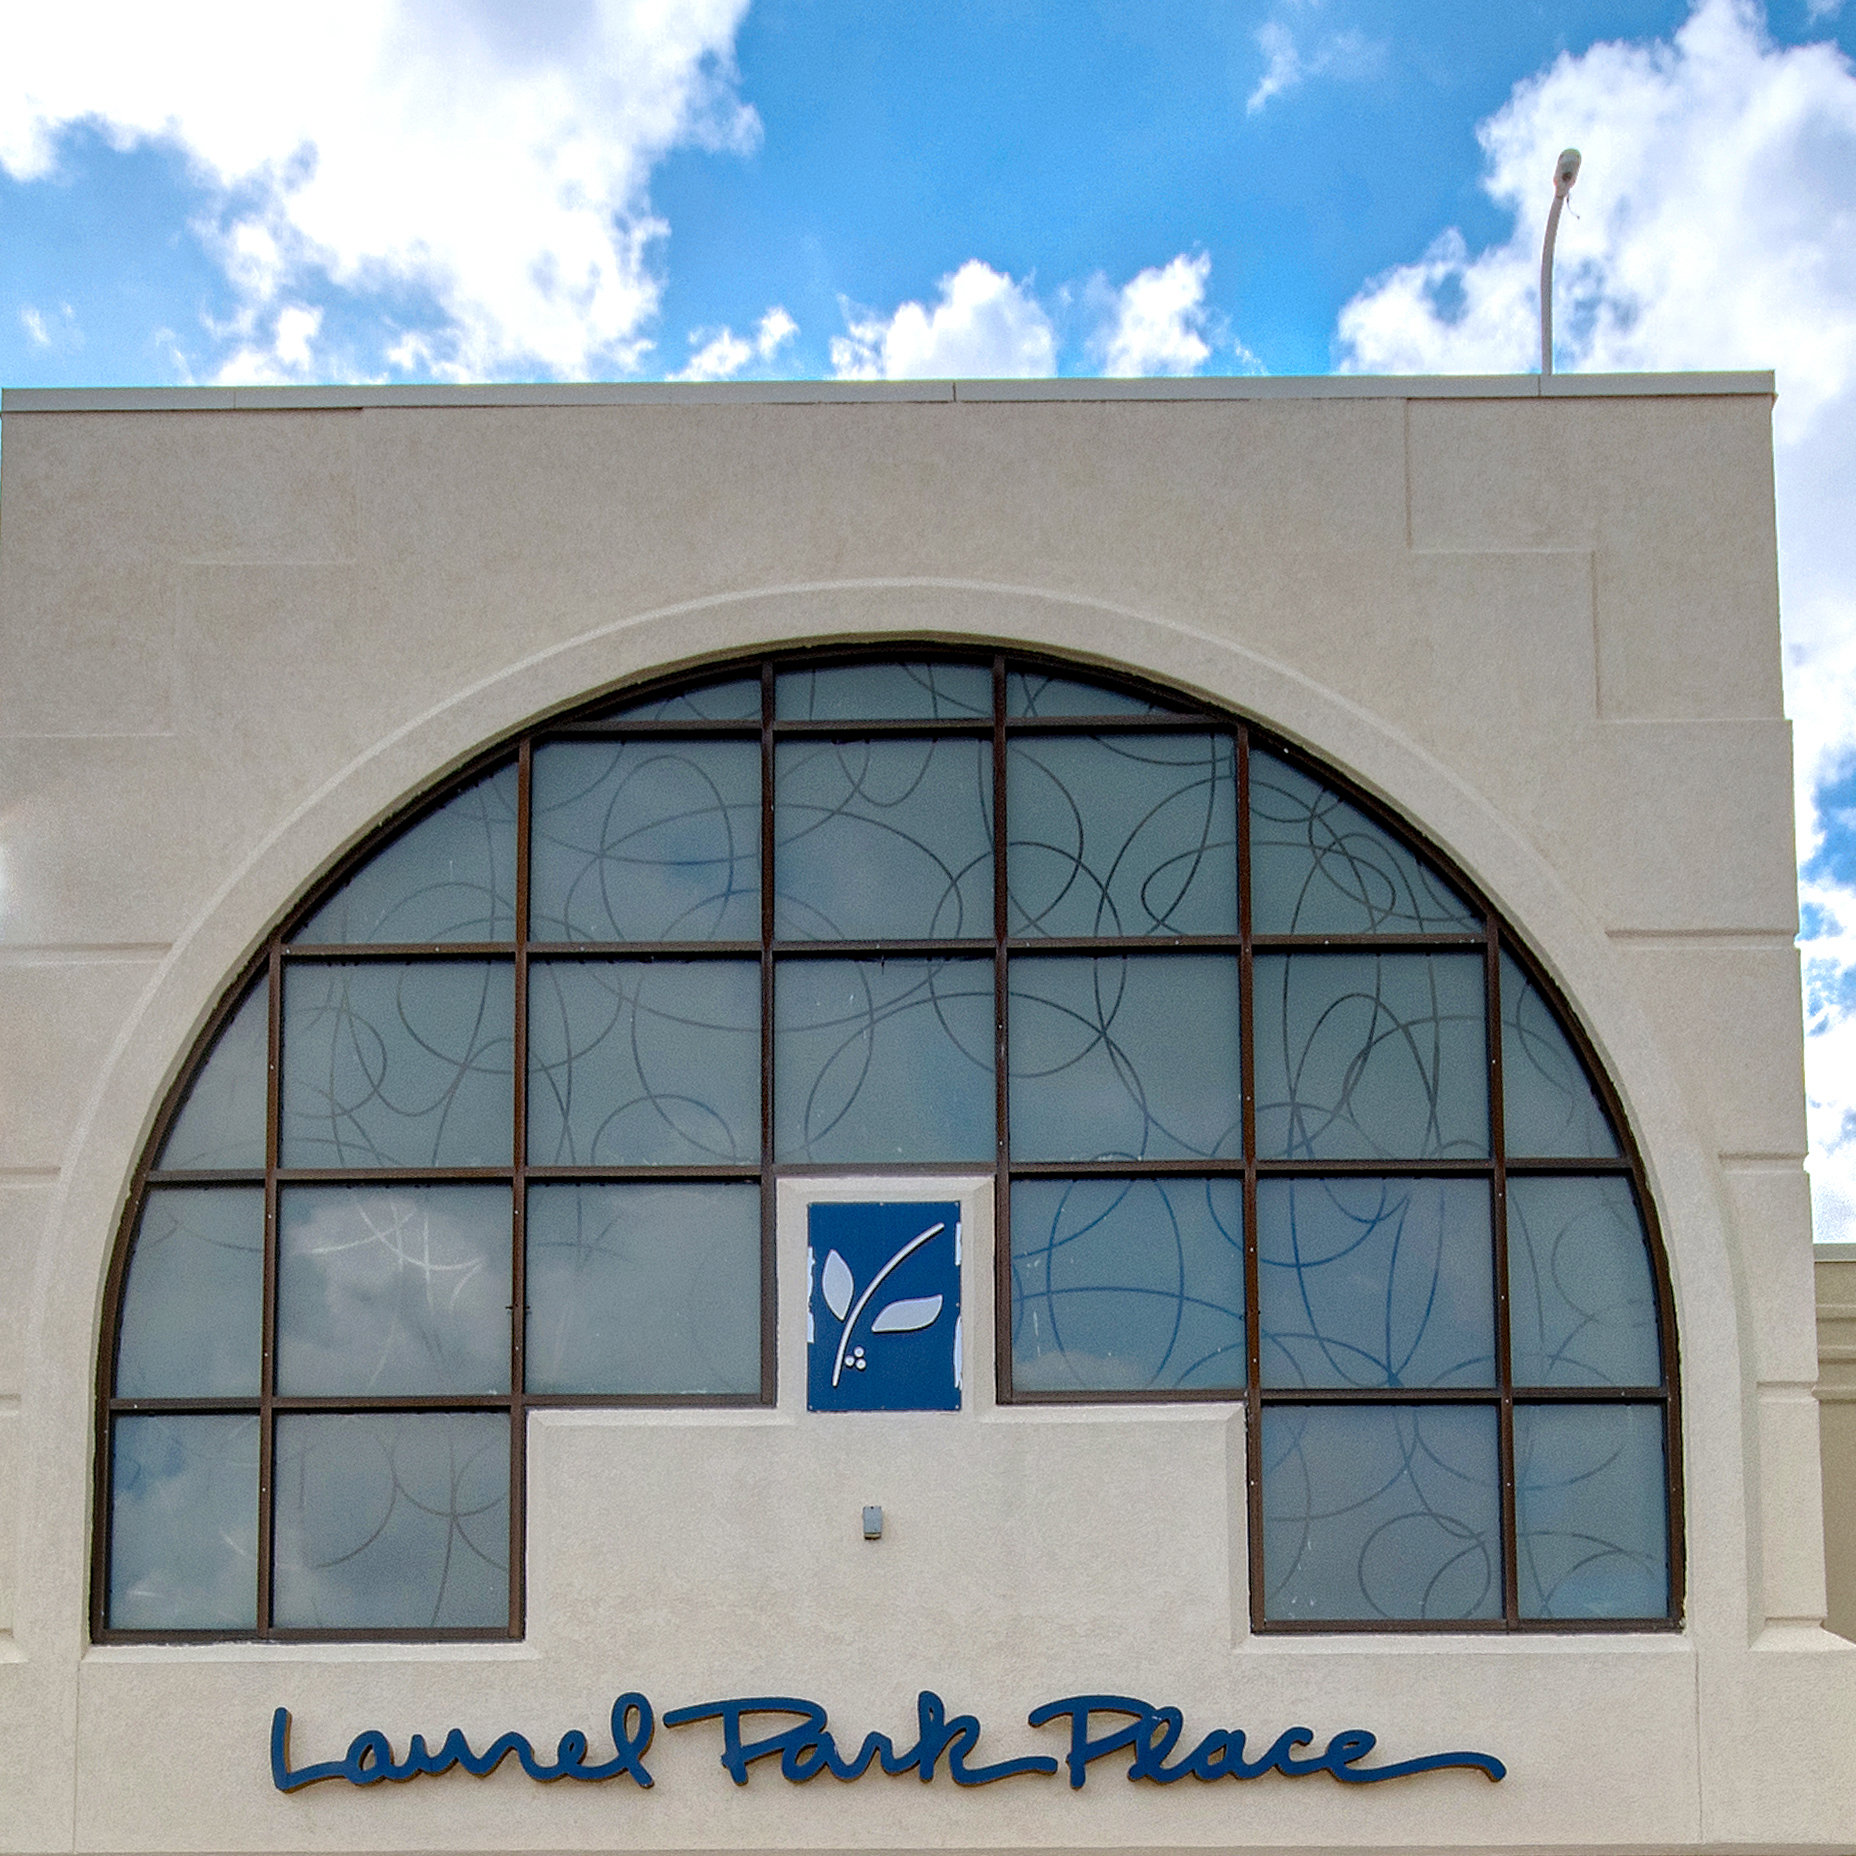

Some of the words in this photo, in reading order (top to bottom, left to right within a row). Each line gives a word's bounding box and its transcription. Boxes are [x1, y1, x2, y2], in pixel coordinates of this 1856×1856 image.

[271, 1692, 655, 1791] Laurel
[663, 1691, 1058, 1786] Park
[1027, 1694, 1506, 1791] Place
